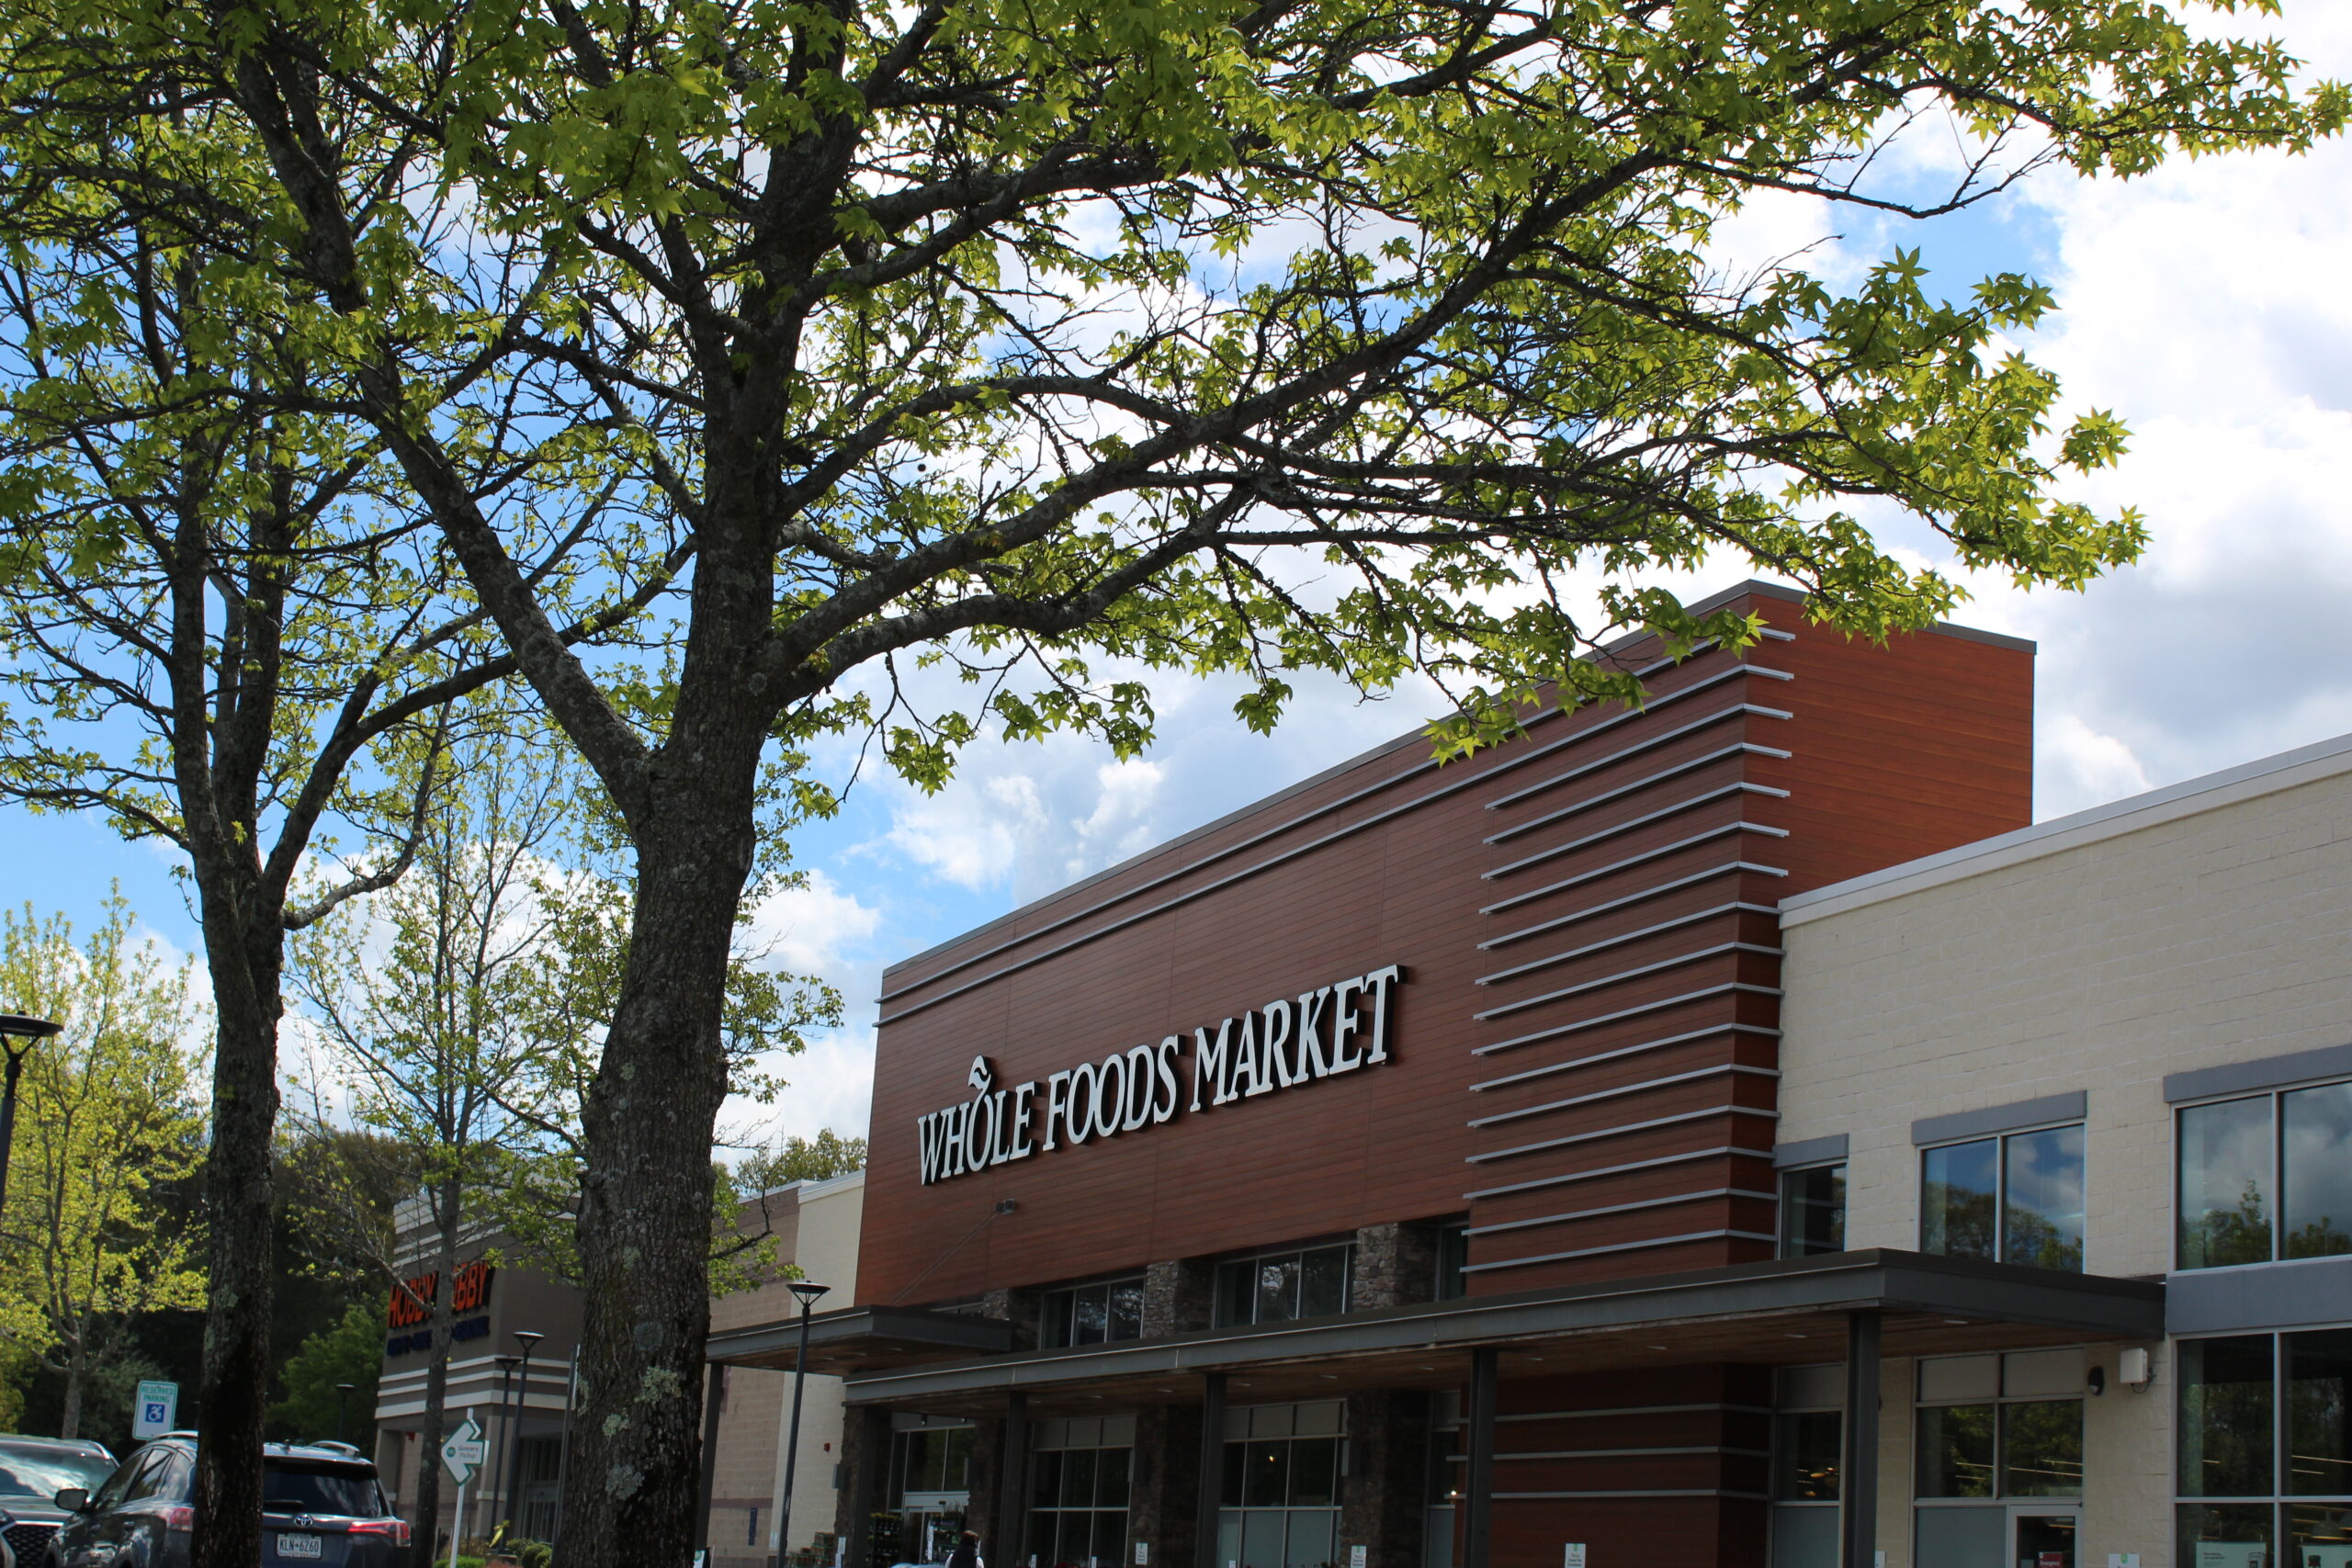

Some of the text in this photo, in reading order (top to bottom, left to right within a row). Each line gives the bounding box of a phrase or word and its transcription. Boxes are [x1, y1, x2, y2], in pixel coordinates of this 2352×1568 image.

[918, 964, 1398, 1185] WHOLE FOODS MARKET
[387, 1270, 436, 1328] HOBBY
[453, 1261, 490, 1312] BBY
[141, 1387, 174, 1395] RESERVED
[143, 1394, 170, 1403] PARKING
